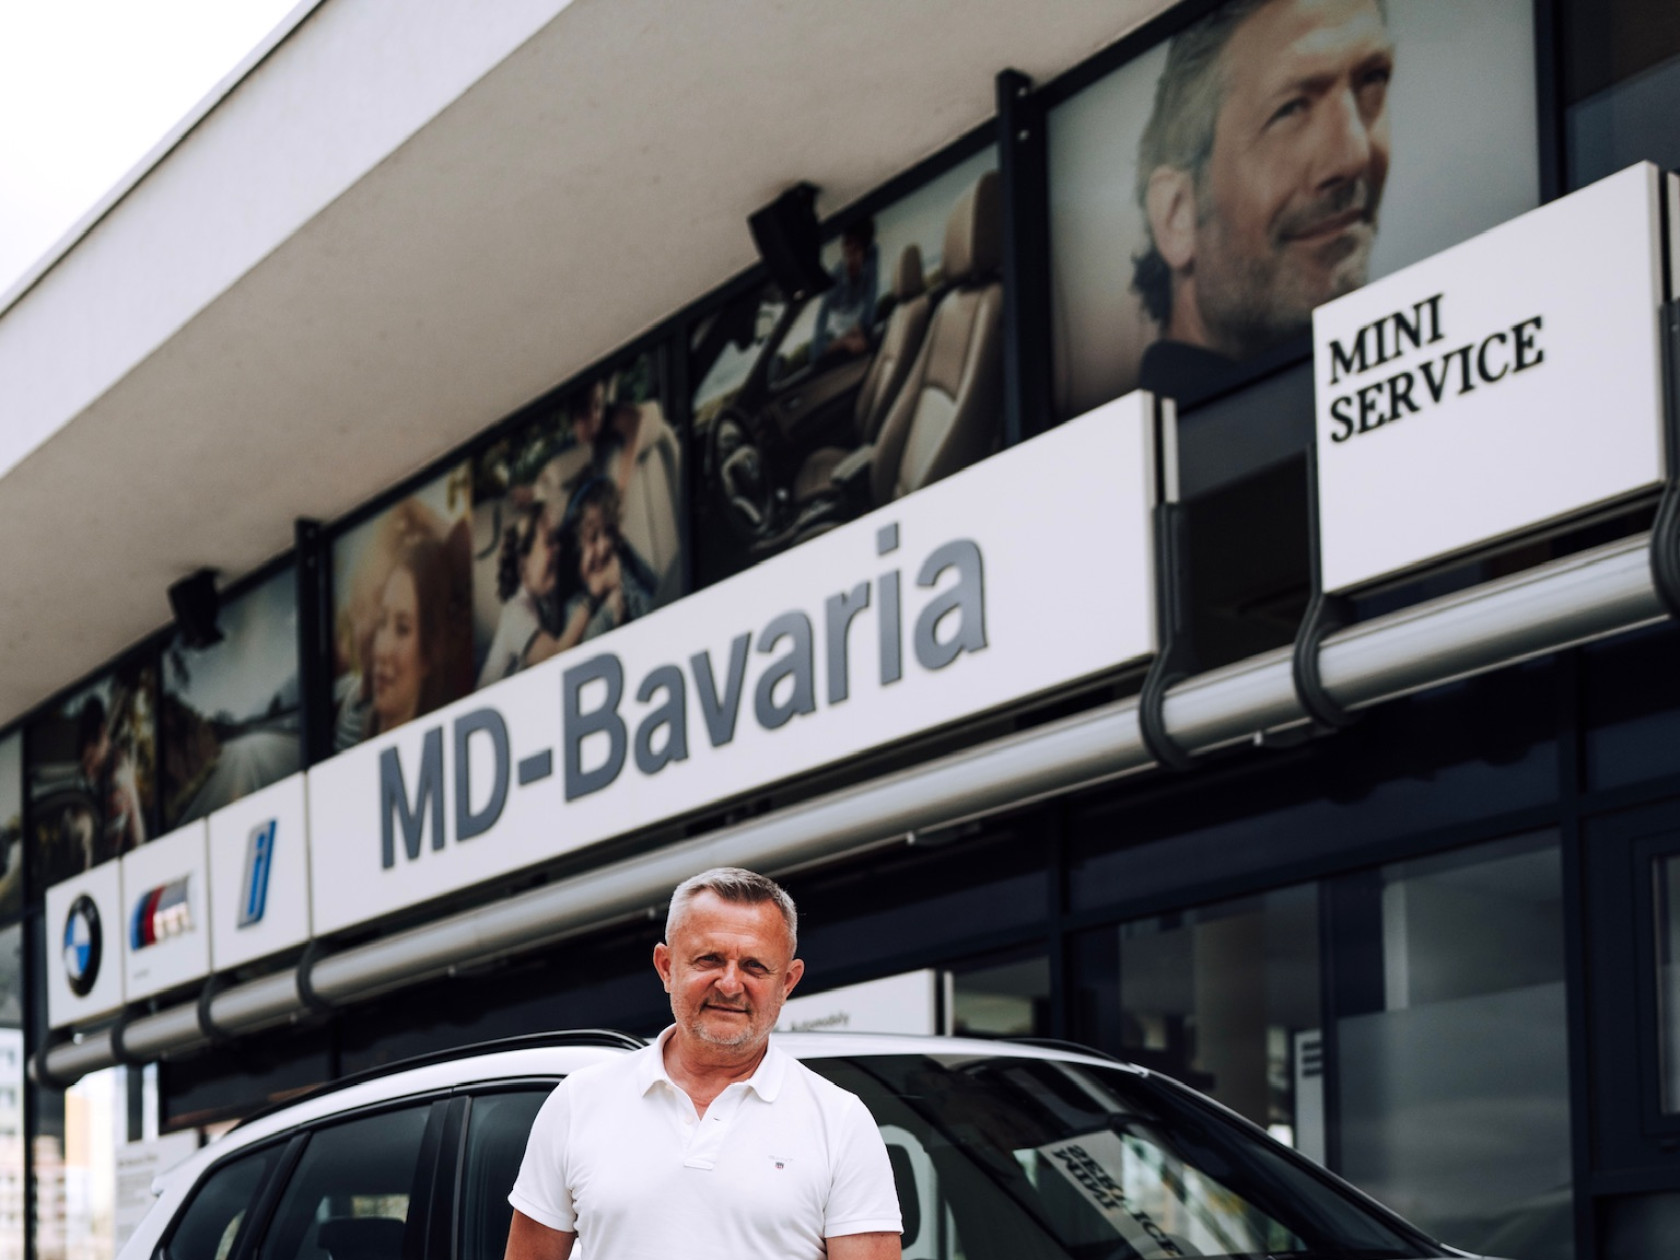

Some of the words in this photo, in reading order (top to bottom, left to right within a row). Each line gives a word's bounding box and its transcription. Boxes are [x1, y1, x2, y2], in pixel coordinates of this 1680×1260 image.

[1328, 293, 1445, 386] MINI
[1329, 315, 1545, 444] SERVICE
[380, 522, 988, 870] MD-Bavaria
